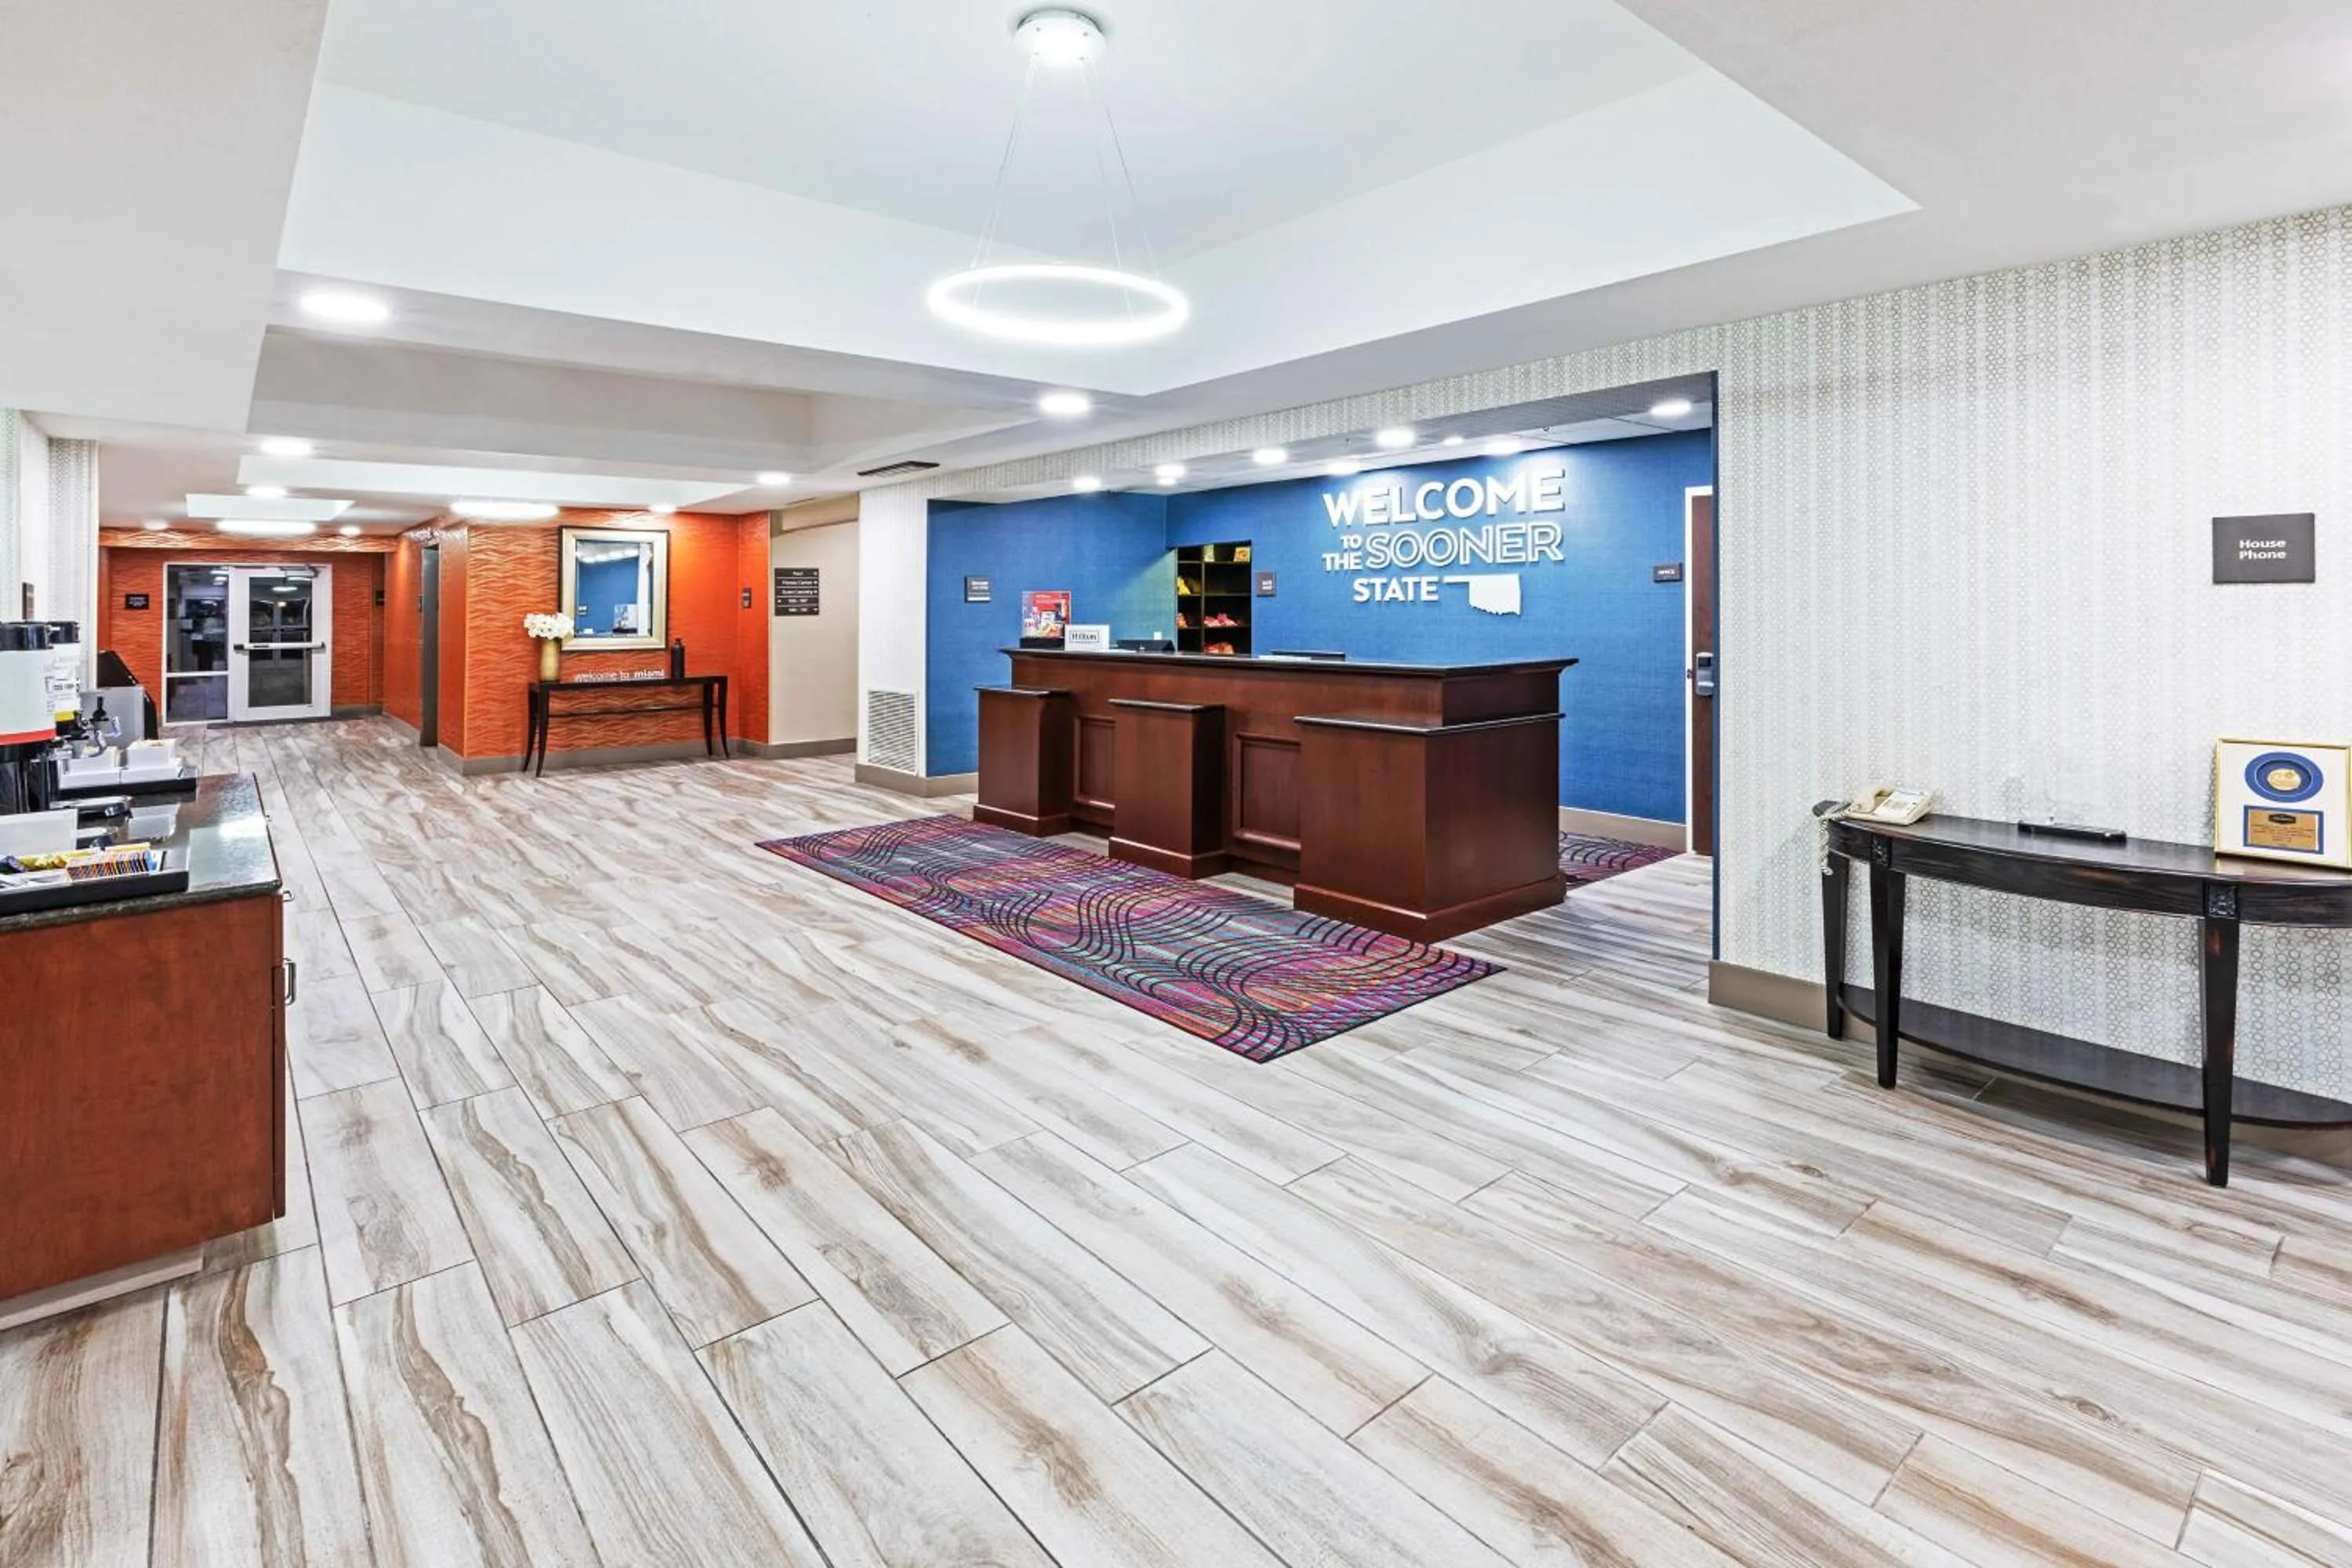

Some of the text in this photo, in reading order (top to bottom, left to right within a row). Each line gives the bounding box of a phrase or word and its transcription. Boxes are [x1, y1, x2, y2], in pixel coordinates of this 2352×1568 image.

[1323, 469, 1565, 527] WELCOME
[1341, 535, 1362, 549] TO
[1366, 521, 1564, 568] SOONER
[2239, 539, 2286, 548] House
[1322, 552, 1363, 571] THE
[2239, 550, 2287, 559] Phone
[1354, 575, 1439, 602] STATE
[634, 669, 664, 679] miami
